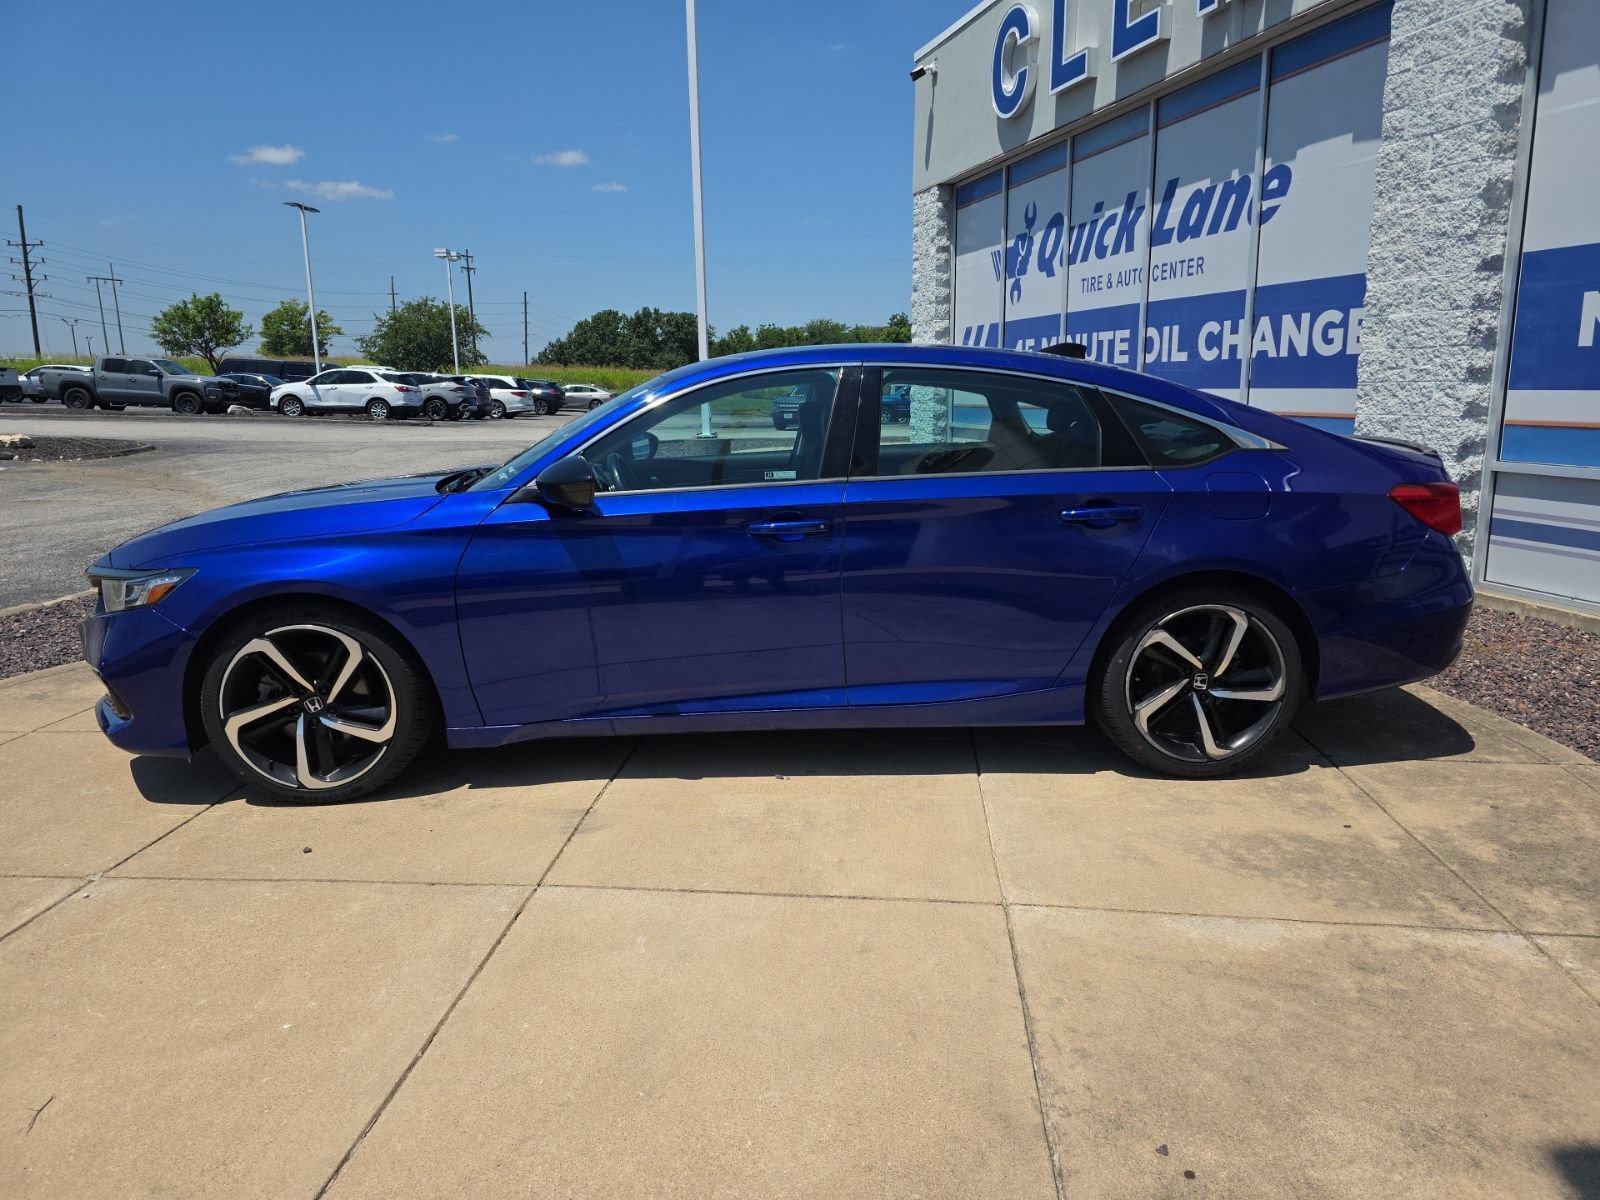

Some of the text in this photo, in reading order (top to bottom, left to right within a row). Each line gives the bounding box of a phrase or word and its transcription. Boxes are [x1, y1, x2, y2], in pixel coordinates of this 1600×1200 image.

[1037, 163, 1293, 278] Quick Lane
[1081, 274, 1104, 294] TIRE
[1106, 272, 1113, 290] &
[1152, 256, 1205, 282] CENTER
[1144, 325, 1188, 364] OIL
[1197, 309, 1365, 362] CHANGE
